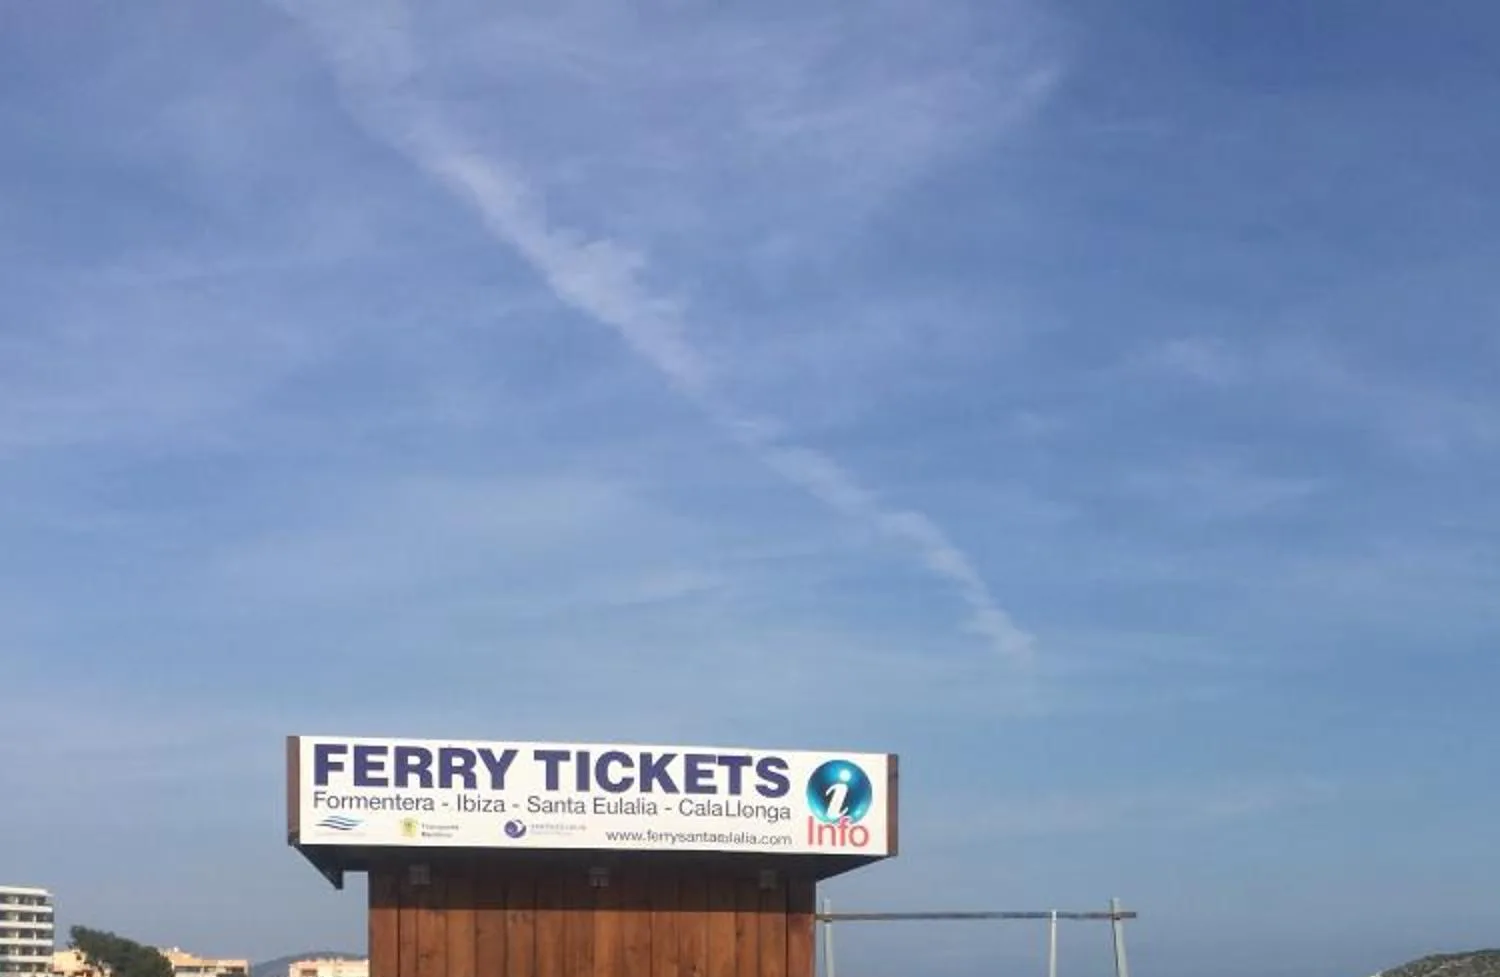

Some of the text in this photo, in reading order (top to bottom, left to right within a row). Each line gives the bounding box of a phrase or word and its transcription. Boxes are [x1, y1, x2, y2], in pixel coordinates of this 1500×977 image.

[313, 743, 791, 799] FERRY TICKETS
[313, 791, 435, 812] Formentera
[456, 793, 506, 813] Ibiza
[526, 796, 587, 815] Santa
[592, 796, 659, 816] Eulalia
[806, 815, 870, 848] Info
